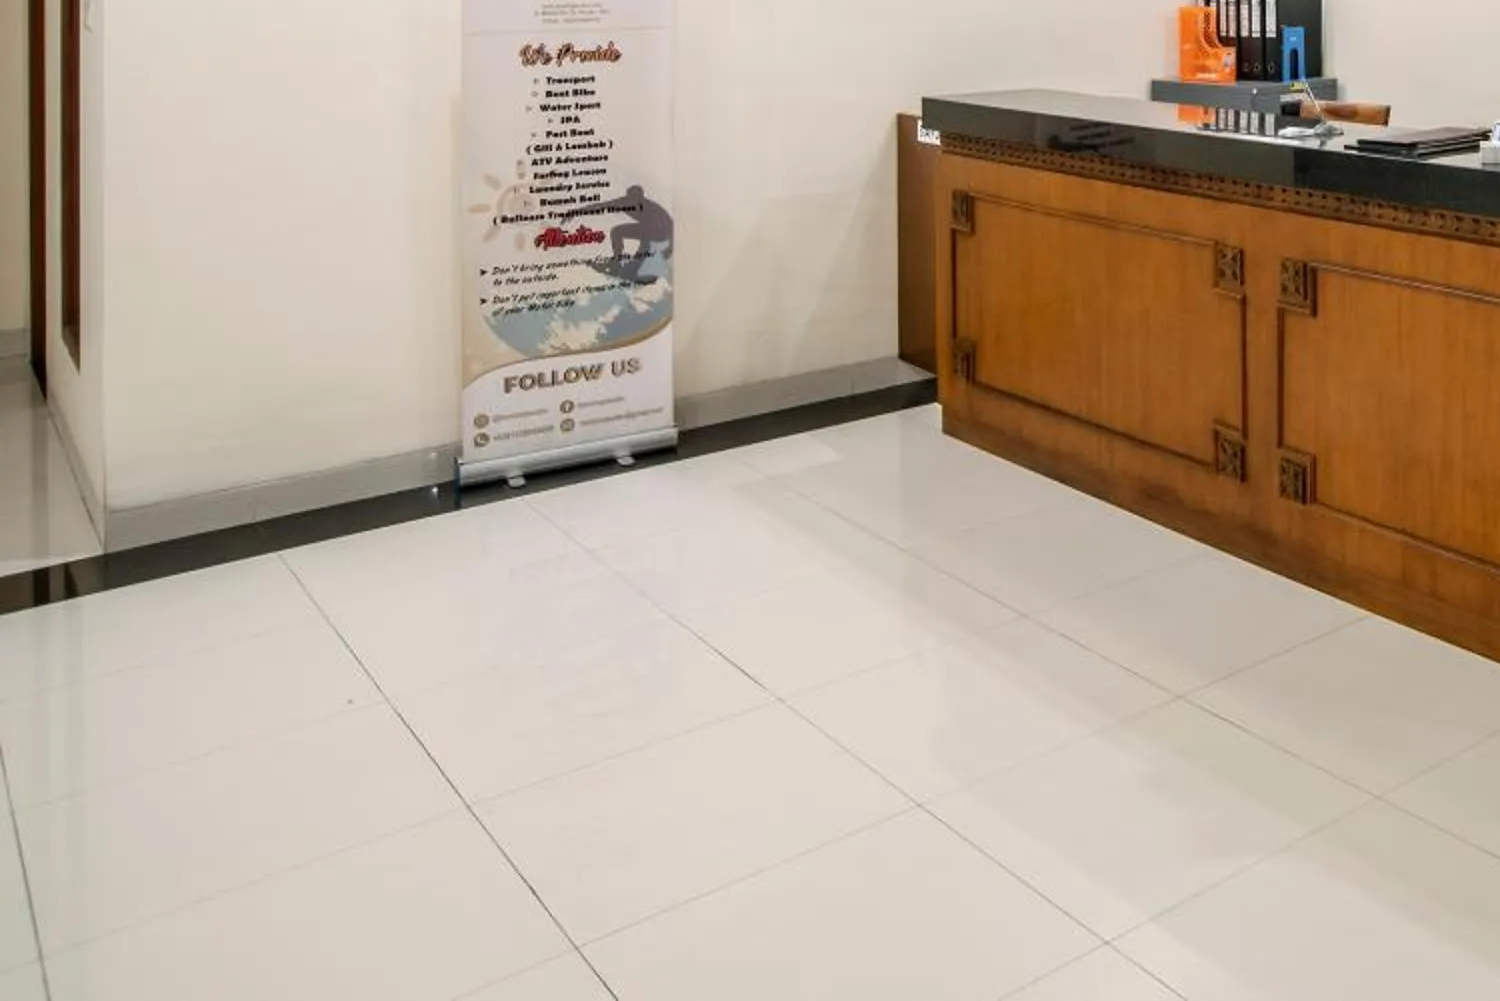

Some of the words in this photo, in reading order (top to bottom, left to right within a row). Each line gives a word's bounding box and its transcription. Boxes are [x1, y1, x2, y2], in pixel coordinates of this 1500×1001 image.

[539, 103, 572, 113] Water
[503, 363, 604, 394] FOLLOW
[610, 357, 641, 378] US
